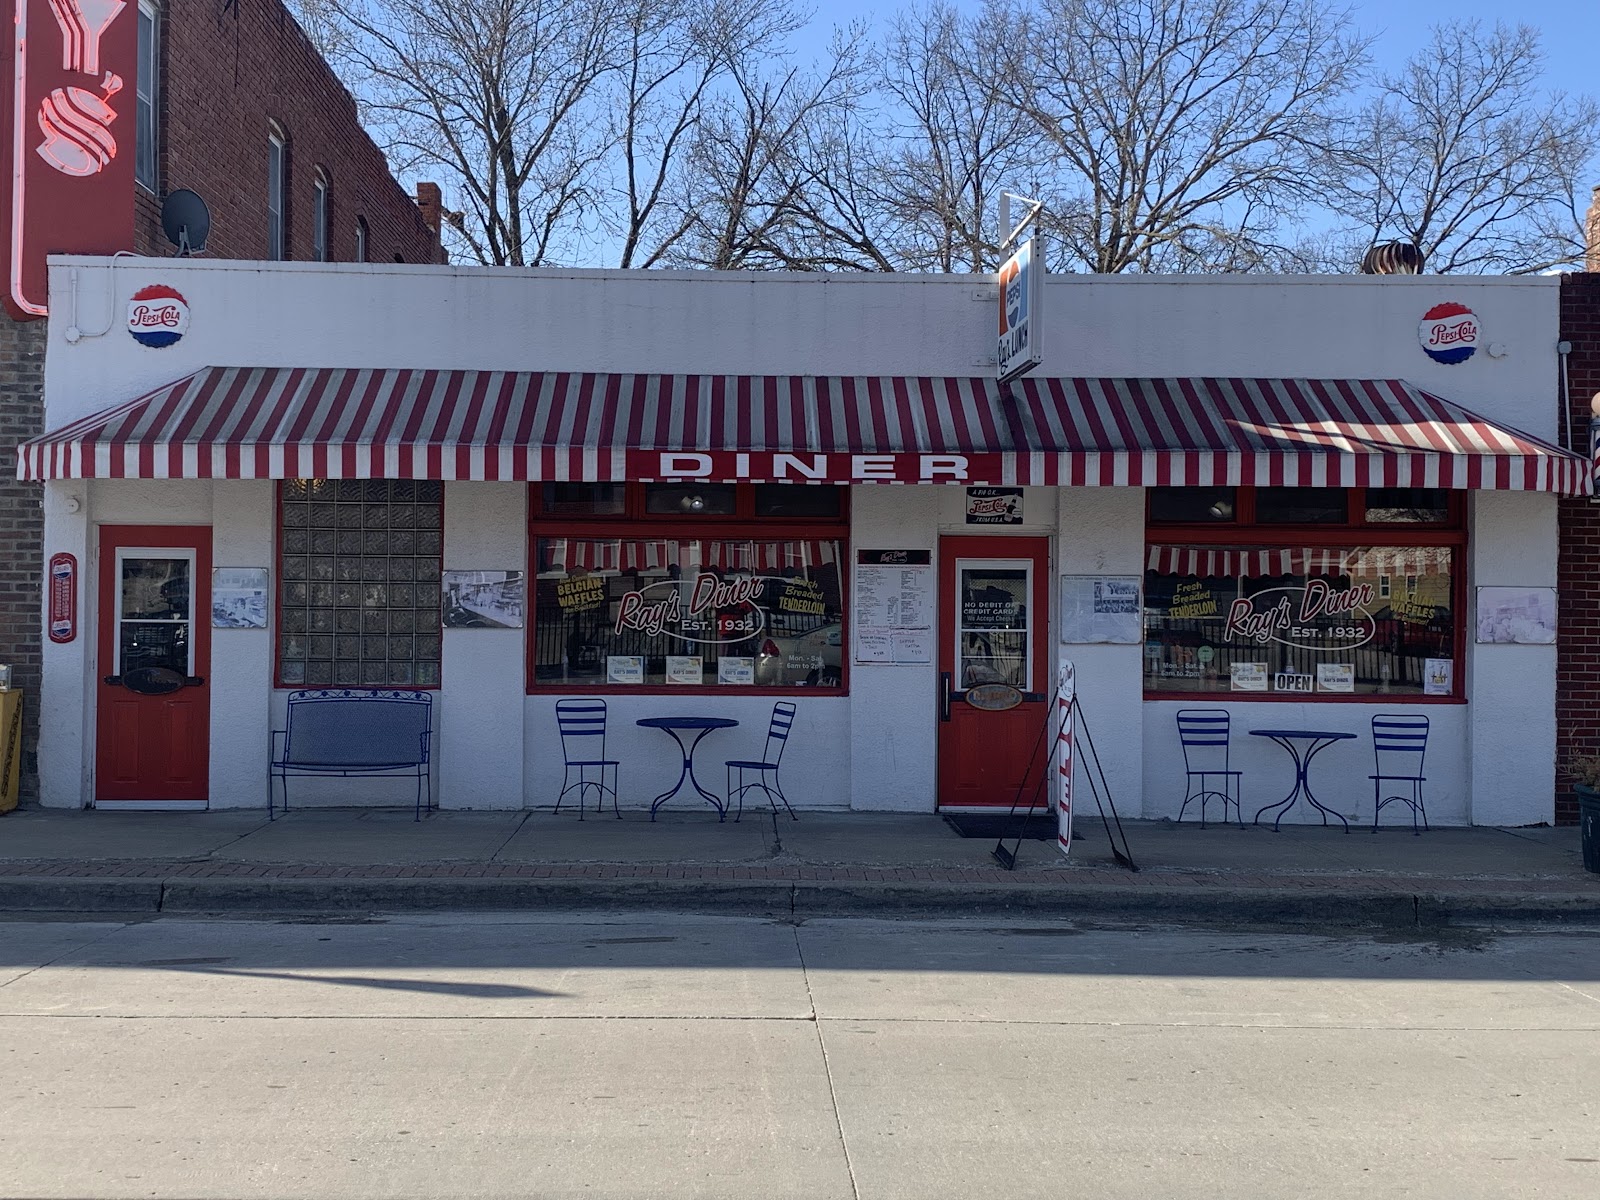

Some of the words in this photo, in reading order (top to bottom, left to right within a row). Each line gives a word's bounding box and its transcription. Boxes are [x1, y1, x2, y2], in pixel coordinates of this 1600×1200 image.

[1006, 280, 1021, 308] PEPSI
[1011, 320, 1029, 357] LUNCH
[660, 452, 969, 480] DINER
[557, 578, 602, 596] BELGIAN
[793, 575, 818, 589] Fresh
[1176, 581, 1203, 593] Fresh
[558, 589, 605, 607] WAFFLES
[785, 586, 824, 600] Breaded
[1172, 590, 1211, 605] Breaded
[614, 589, 681, 637] Ray's
[690, 572, 764, 616] Diner
[779, 596, 826, 615] TENDERLOIN
[1168, 600, 1218, 618] TENDERLOIN
[1224, 596, 1291, 643] Ray's
[1299, 579, 1375, 622] Diner
[1390, 601, 1436, 619] WAFFLES
[681, 620, 712, 631] EST.
[717, 620, 755, 631] 1932
[1291, 626, 1322, 638] EST.
[1328, 626, 1366, 638] 1932
[1277, 674, 1310, 691] OPEN
